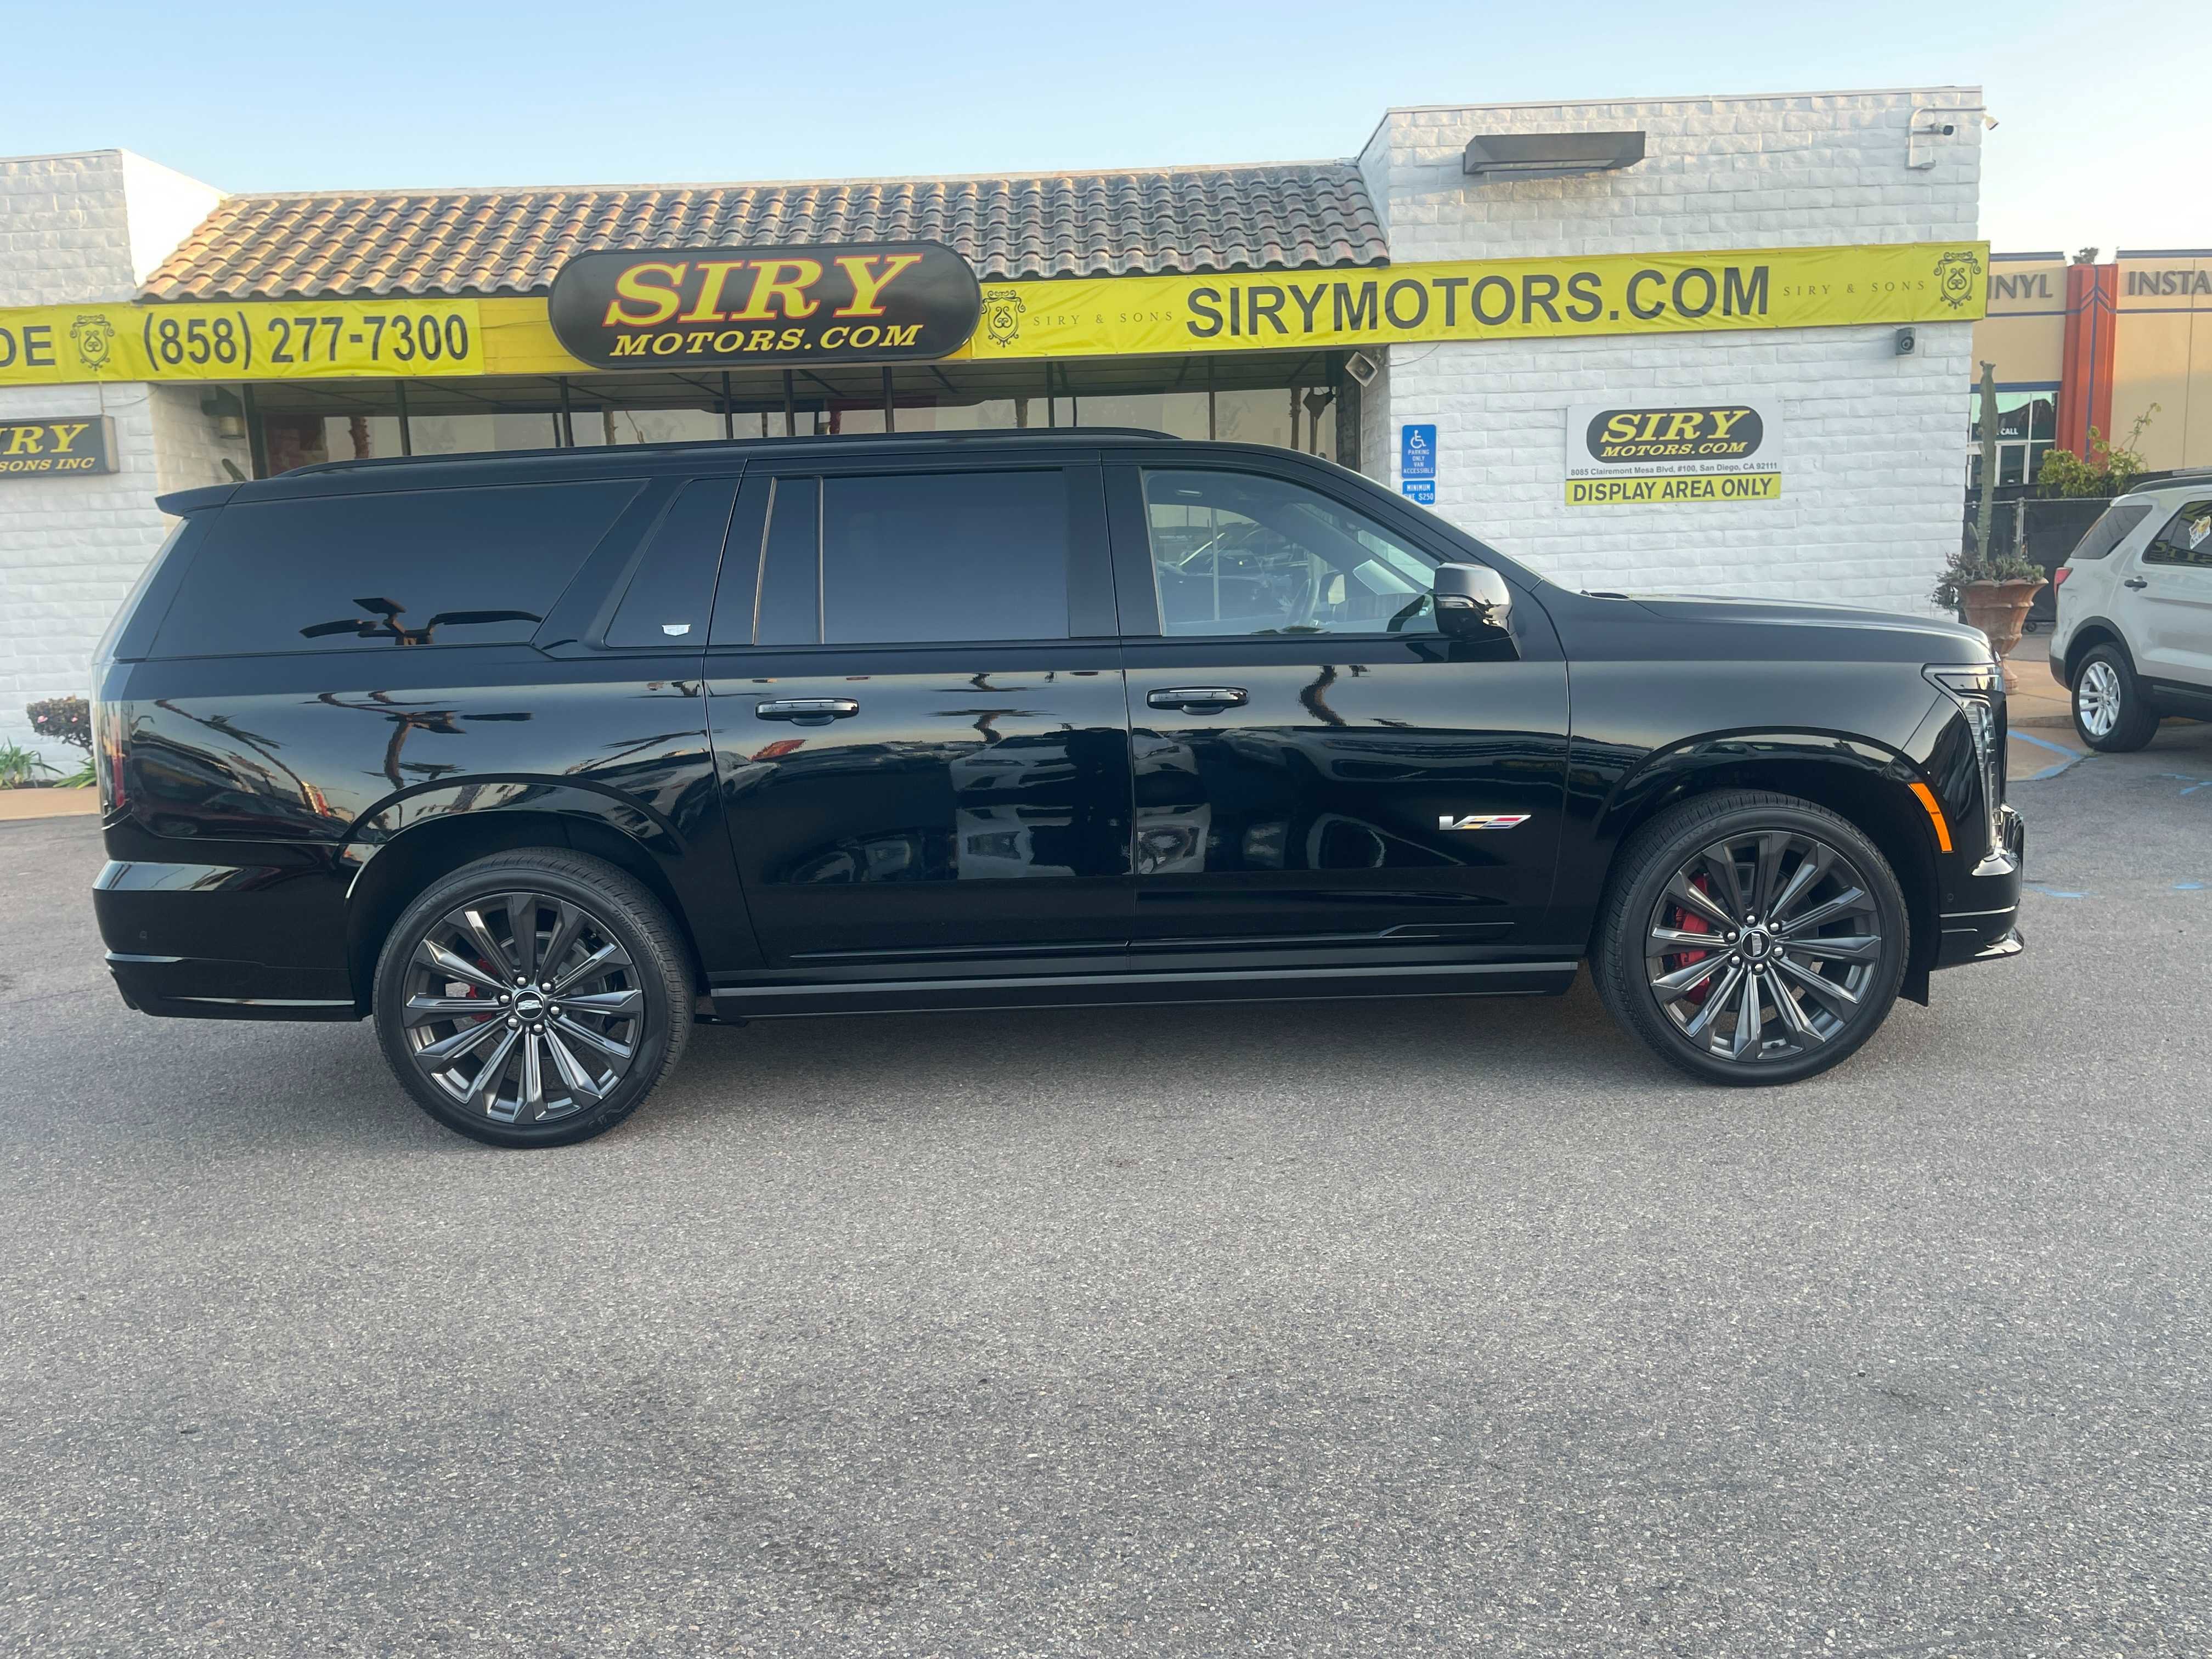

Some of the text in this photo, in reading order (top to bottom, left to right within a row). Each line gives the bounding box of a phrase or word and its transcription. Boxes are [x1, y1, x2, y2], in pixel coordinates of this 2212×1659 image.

[602, 253, 923, 327] SIRY
[1784, 280, 1924, 296] SIRY & SONS
[2129, 270, 2212, 295] INSTA
[1186, 265, 1769, 338] SIRYMOTORS.COM
[1034, 311, 1173, 326] SIRY & SONS
[144, 312, 469, 371] (858) 277-7300
[610, 324, 923, 357] MOTORS.COM
[1600, 410, 1750, 443] SIRY
[1600, 442, 1748, 457] MOTORS.COM
[55, 457, 95, 470] INC
[1573, 478, 1773, 501] DISPLAY AREA ONLY
